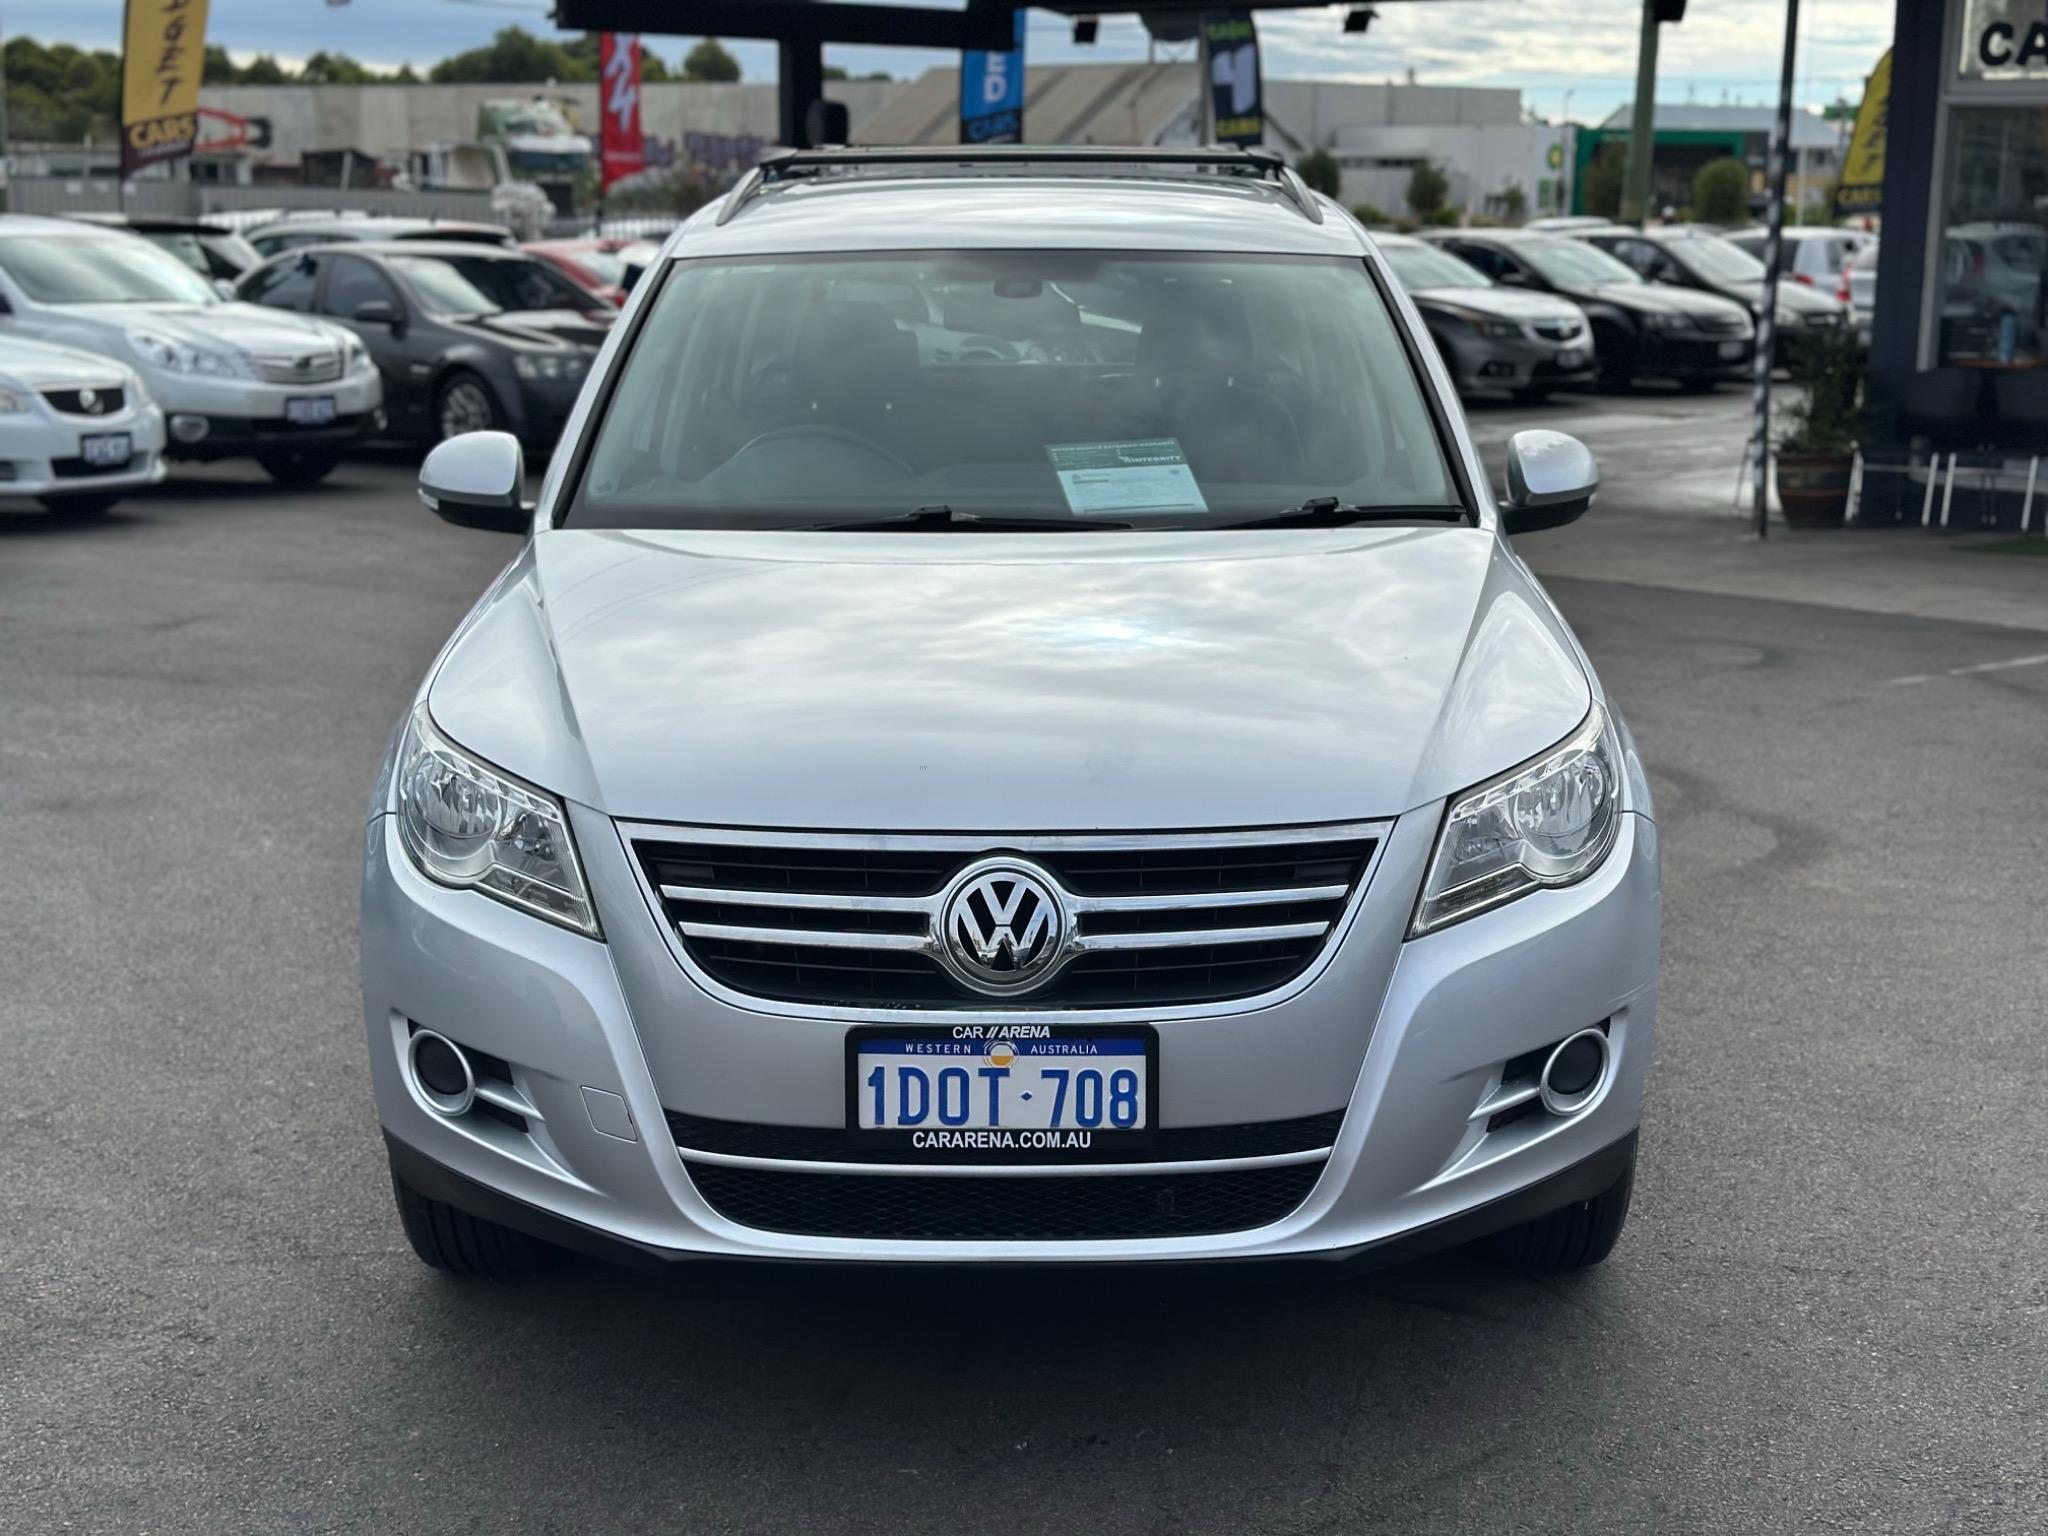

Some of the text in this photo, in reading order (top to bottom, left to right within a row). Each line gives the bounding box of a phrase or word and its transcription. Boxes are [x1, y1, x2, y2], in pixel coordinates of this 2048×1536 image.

[129, 113, 198, 149] CARS
[905, 1043, 1098, 1055] WESTERN AUSTRALIA
[912, 1131, 1092, 1148] CARARENA.COM.AU
